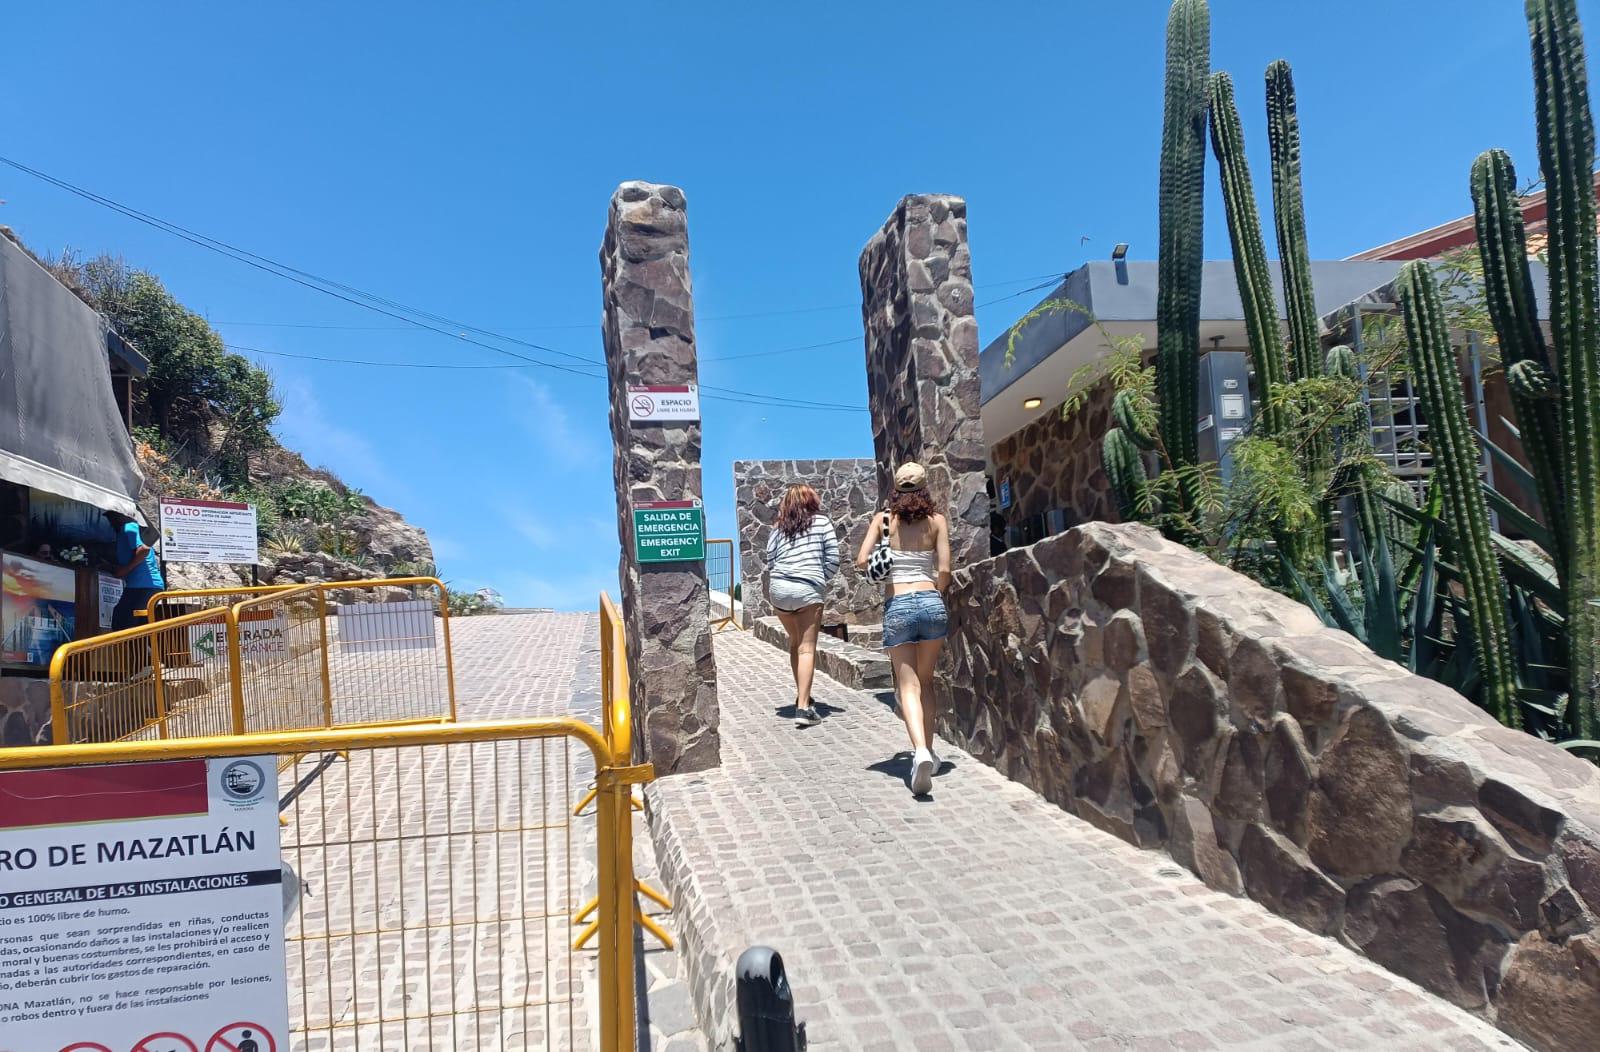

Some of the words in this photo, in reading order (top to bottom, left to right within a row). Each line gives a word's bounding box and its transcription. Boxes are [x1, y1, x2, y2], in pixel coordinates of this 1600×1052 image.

[175, 508, 200, 517] ALTO
[643, 513, 678, 521] SALIDA
[679, 512, 692, 520] DE
[638, 523, 700, 533] EMERGENCIA
[641, 537, 698, 547] EMERGENCY
[660, 548, 681, 557] EXIT
[216, 628, 282, 643] ERADA
[48, 843, 87, 867] DE
[97, 826, 255, 864] MAZATLÁN
[13, 889, 82, 905] GENERAL
[86, 886, 106, 899] DE
[110, 884, 136, 897] LAS
[139, 874, 249, 895] INSTALACIONES
[14, 916, 25, 924] es
[28, 913, 56, 923] 100%
[58, 911, 80, 920] libre
[83, 909, 95, 918] de
[98, 907, 130, 916] humo.
[40, 932, 59, 942] que
[66, 929, 90, 938] sean
[97, 921, 163, 935] sorprendidas
[169, 920, 181, 928] en
[188, 916, 214, 926] riñas,
[221, 911, 269, 923] conductas
[2, 956, 32, 967] moral
[34, 957, 40, 965] y
[43, 952, 79, 963] buenas
[81, 947, 143, 959] costumbres,
[144, 945, 155, 953] se
[158, 943, 171, 951] les
[174, 936, 218, 951] prohibirá
[220, 936, 228, 945] el
[230, 933, 262, 944] acceso
[264, 932, 270, 941] y
[23, 940, 87, 954] ocasionando
[89, 936, 120, 947] daños
[132, 934, 146, 943] las
[148, 928, 211, 941] instalaciones
[213, 925, 229, 936] y/o
[232, 921, 269, 933] realicen
[44, 966, 58, 975] las
[63, 960, 123, 973] autoridades
[126, 950, 215, 966] correspondientes,
[217, 948, 229, 956] en
[233, 946, 255, 954] caso
[258, 943, 270, 951] de
[15, 976, 57, 989] deberán
[59, 973, 89, 984] cubrir
[91, 972, 106, 980] los
[107, 968, 140, 981] gastos
[141, 967, 154, 975] de
[156, 961, 211, 975] reparación.
[24, 997, 75, 1009] Mazatlán,
[80, 995, 93, 1003] no
[98, 993, 109, 1001] se
[115, 990, 139, 999] hace
[145, 982, 204, 995] responsable
[208, 980, 225, 989] por
[231, 974, 272, 986] lesiones,
[11, 1012, 40, 1022] robos
[42, 1008, 76, 1018] dentro
[78, 1007, 84, 1016] y
[87, 1004, 113, 1014] fuera
[115, 1001, 127, 1010] de
[130, 1000, 144, 1008] las
[146, 993, 210, 1007] instalaciones
